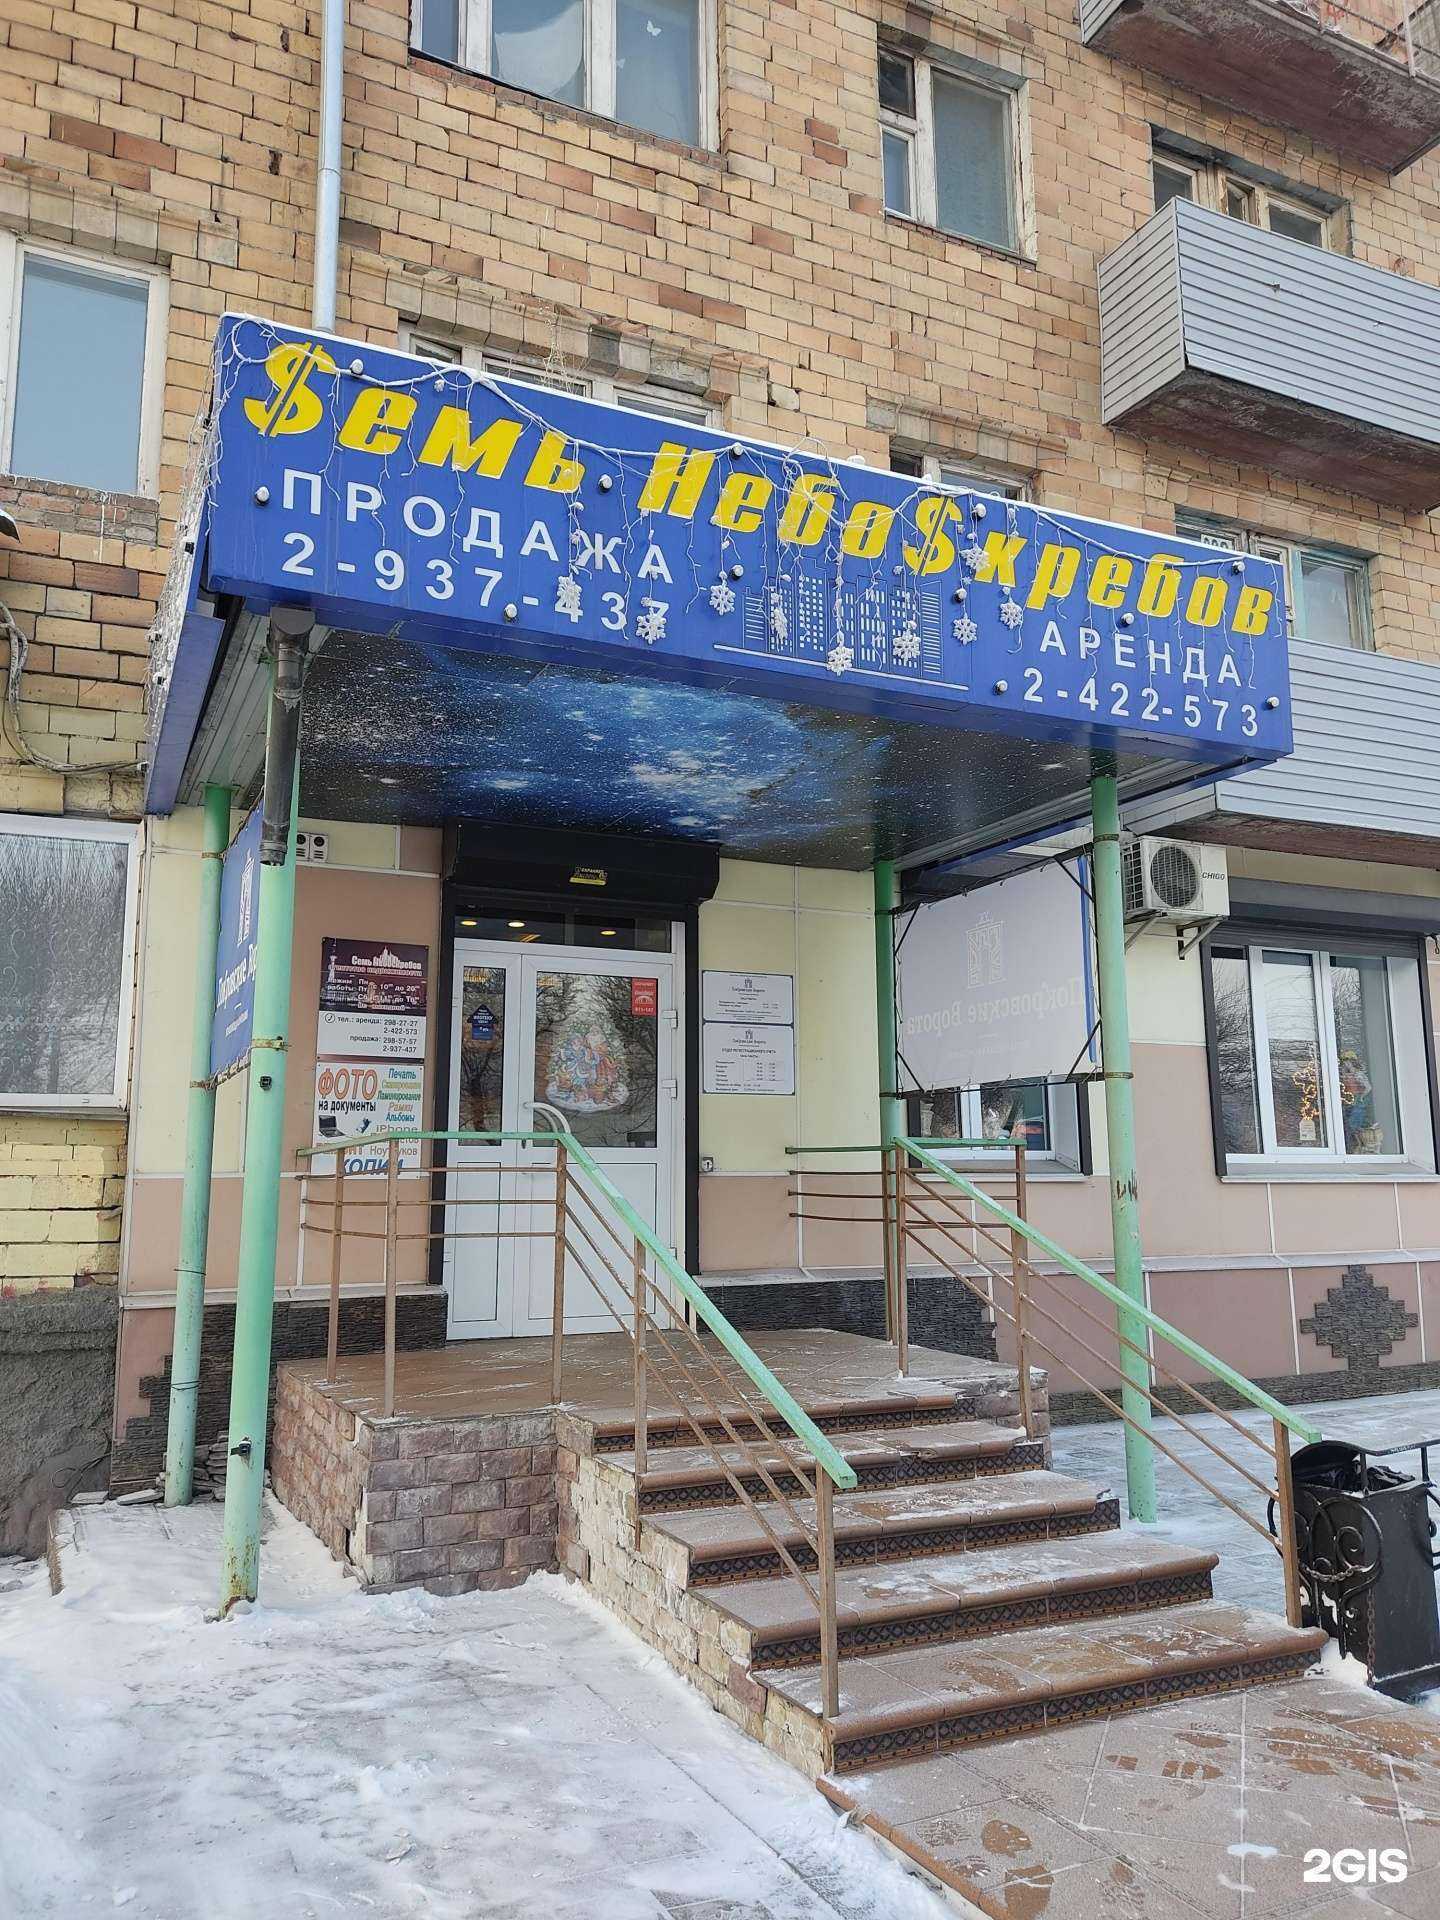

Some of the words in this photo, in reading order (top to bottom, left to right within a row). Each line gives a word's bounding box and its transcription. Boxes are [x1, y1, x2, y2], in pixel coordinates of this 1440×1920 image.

[282, 468, 675, 585] ПРОДАЖА
[282, 532, 670, 638] 2-937-437
[1039, 620, 1242, 689] АРЕНДА
[1023, 667, 1259, 738] 2-422-573
[384, 1019, 418, 1027] 298-27-27
[383, 1027, 418, 1035] 2-422-573
[383, 1037, 417, 1045] 298-57-57
[382, 1045, 417, 1053] 2-937-437
[318, 1067, 378, 1100] ФОТО
[388, 1068, 417, 1079] Печать
[318, 1100, 328, 1111] на
[330, 1101, 377, 1114] документы
[385, 1111, 415, 1122] Альбомы
